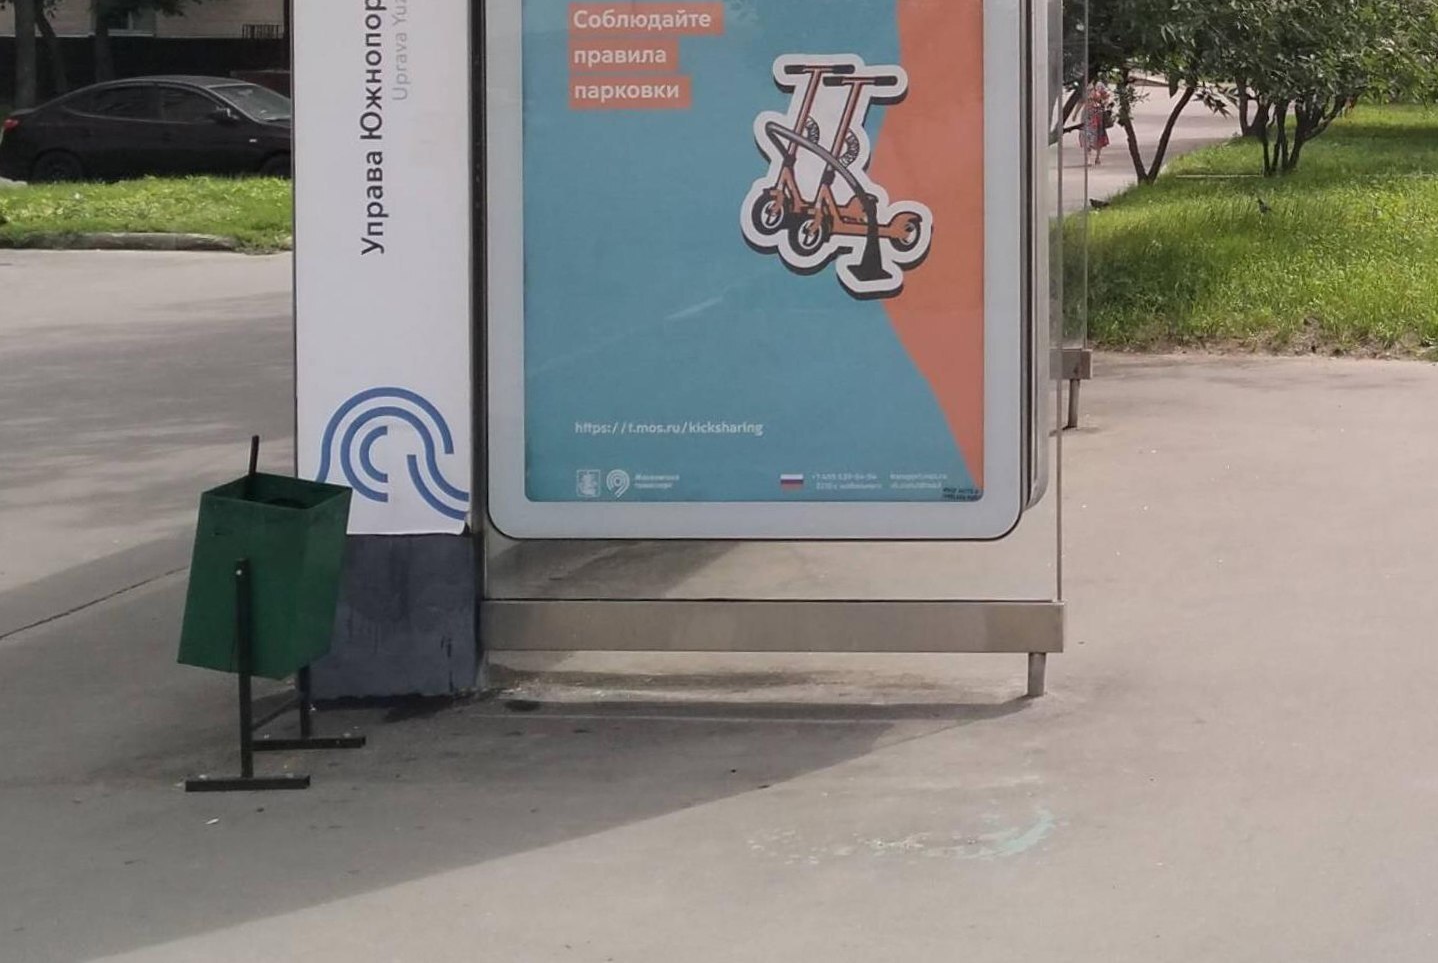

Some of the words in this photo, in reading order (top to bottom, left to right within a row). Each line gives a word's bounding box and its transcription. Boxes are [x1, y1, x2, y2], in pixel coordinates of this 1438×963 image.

[573, 9, 712, 30] Соблюдайте
[392, 32, 411, 101] Uprava
[574, 48, 667, 67] правила
[574, 84, 679, 103] парковки
[361, 151, 389, 255] Управа
